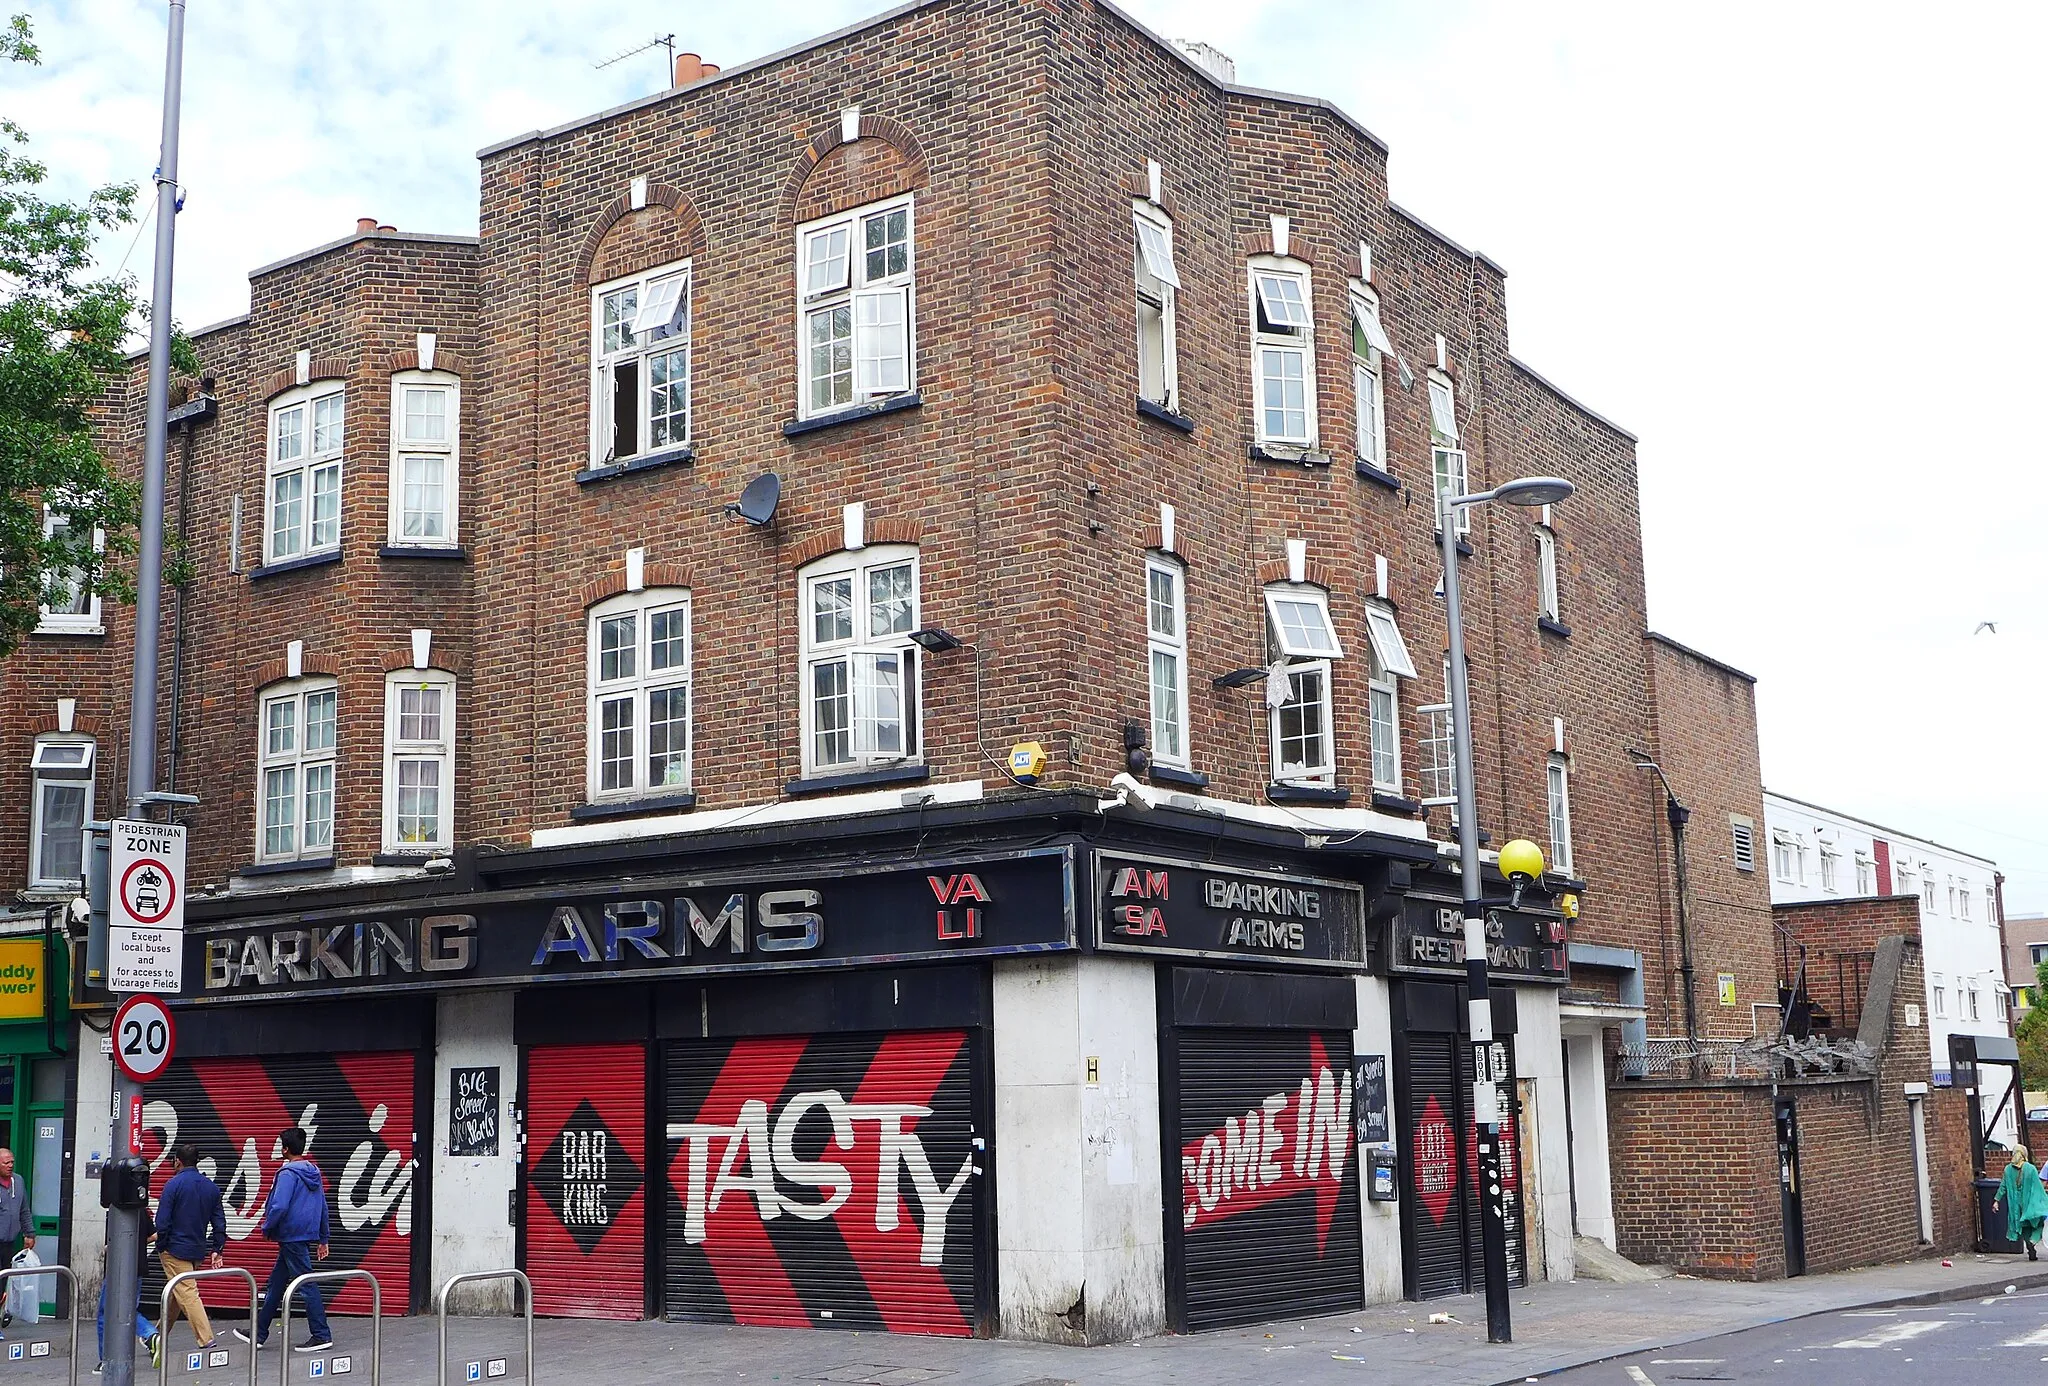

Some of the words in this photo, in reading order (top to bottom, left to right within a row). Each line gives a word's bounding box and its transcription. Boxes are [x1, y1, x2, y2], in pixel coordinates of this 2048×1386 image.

[118, 824, 181, 838] PEDESTRIAN
[126, 837, 171, 854] ZONE
[926, 873, 992, 905] VA
[1115, 867, 1168, 901] AM
[1204, 878, 1320, 919] BARKING
[131, 931, 162, 943] Except
[936, 908, 982, 942] LI
[1118, 904, 1168, 938] SA
[1228, 916, 1305, 951] ARMS
[1486, 910, 1504, 939] &
[121, 942, 143, 952] local
[146, 944, 171, 953] buses
[204, 914, 478, 989] BARKING
[530, 888, 826, 967] ARMS
[1411, 935, 1532, 970] RESTARANT
[0, 964, 35, 980] ddy
[116, 966, 130, 976] for
[132, 969, 162, 977] access
[164, 969, 174, 977] to
[137, 956, 155, 964] and
[111, 977, 150, 988] Vicarage
[153, 979, 179, 988] Fields
[123, 1020, 167, 1056] 20
[1087, 1058, 1098, 1081] H
[1476, 1046, 1485, 1086] ZB002
[458, 1070, 488, 1097] BIG
[131, 1103, 140, 1124] butts
[1293, 1065, 1353, 1183] IN
[41, 1127, 55, 1138] 23A
[562, 1130, 607, 1180] BAR
[666, 1089, 973, 1267] TASTY
[563, 1183, 608, 1225] KING
